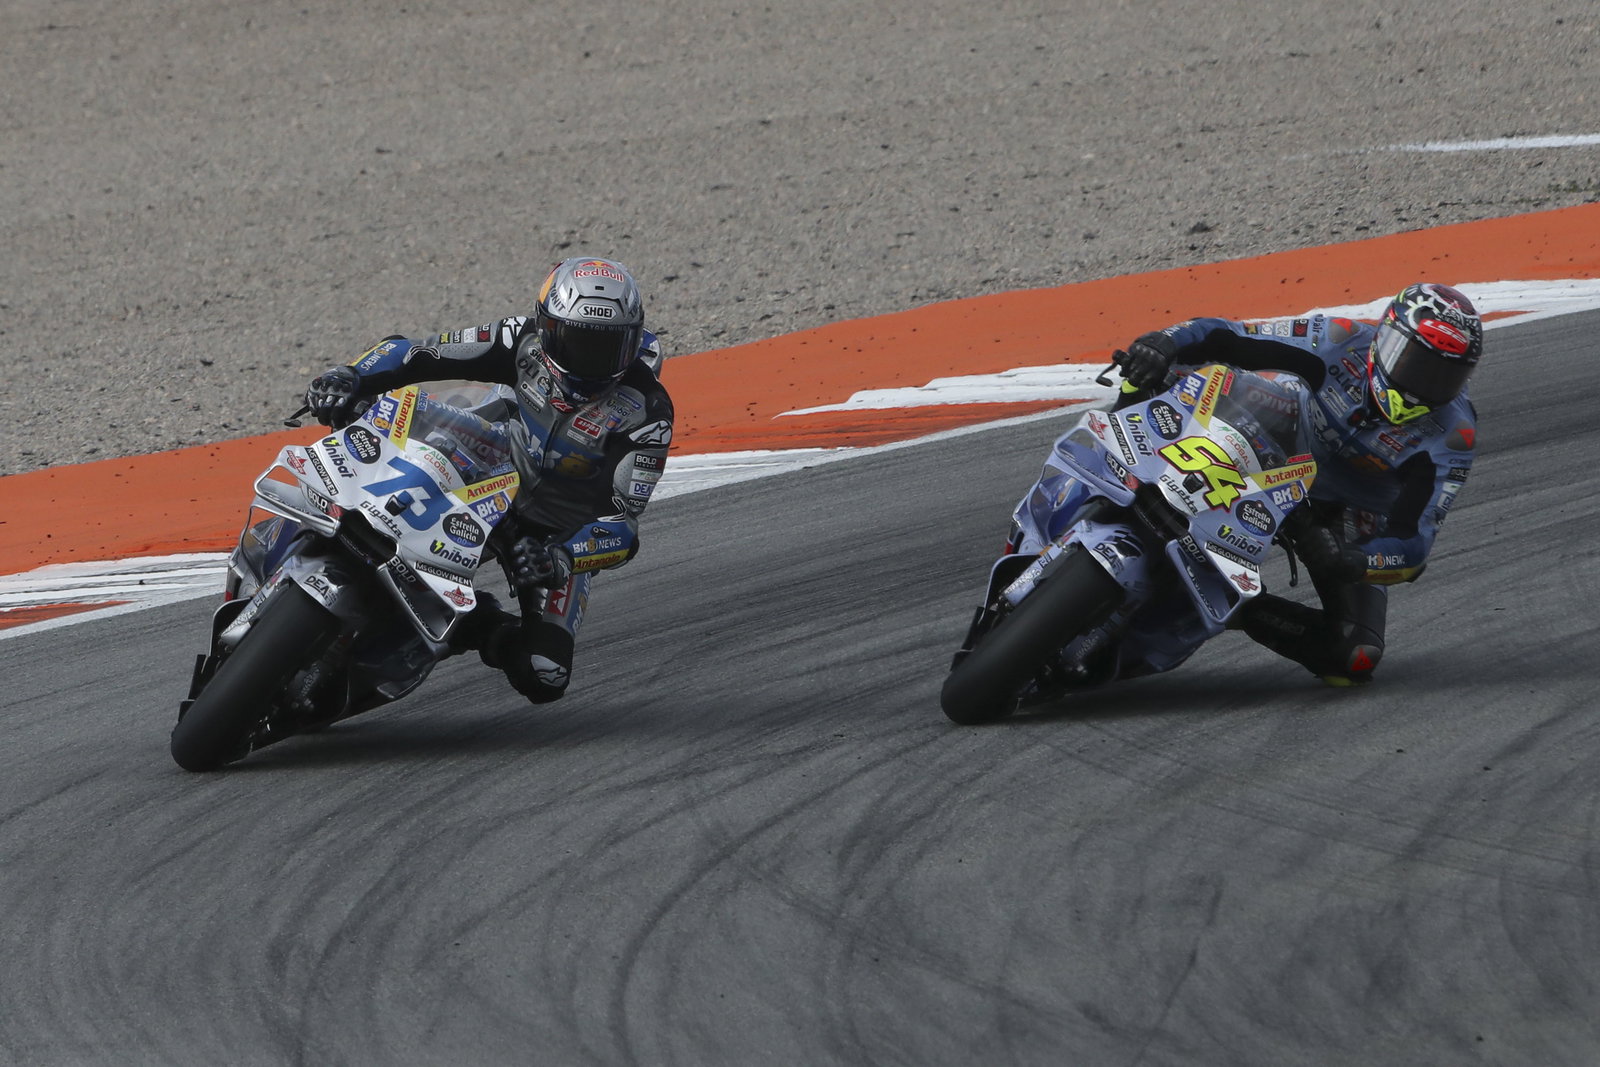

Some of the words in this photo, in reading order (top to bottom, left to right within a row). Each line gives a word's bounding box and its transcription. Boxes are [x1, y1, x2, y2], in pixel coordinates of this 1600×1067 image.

[575, 268, 599, 278] Red
[601, 269, 624, 282] Bull
[565, 320, 587, 329] GIVES
[583, 306, 613, 318] SHOEI
[1180, 375, 1202, 405] BK8
[1199, 368, 1224, 416] Antangin
[373, 400, 395, 430] BK8
[394, 391, 416, 439] Antangin
[1153, 408, 1169, 434] Galicia
[1160, 405, 1178, 433] Estrella
[350, 433, 367, 459] Galicia
[355, 430, 376, 457] Estrella
[1126, 413, 1153, 457] Unibat
[322, 437, 353, 479] Unibat
[429, 450, 448, 466] AUS
[636, 455, 657, 465] BOLD
[1225, 435, 1250, 468] GLOBAL
[423, 454, 453, 485] GLOBAL
[1106, 454, 1126, 477] BOLD
[1157, 435, 1247, 512] 54
[1265, 465, 1313, 485] Antangin
[308, 489, 328, 509] BOLD
[467, 475, 515, 500] Antangin
[1159, 474, 1199, 517] Gigetta
[1272, 483, 1301, 506] BK8
[477, 495, 507, 516] BK8
[1244, 504, 1271, 524] Estrella
[360, 501, 402, 538] Gigetta
[451, 517, 480, 535] Estrella
[1242, 512, 1268, 530] Galicia
[450, 526, 477, 542] Galicia
[572, 538, 597, 553] BK8
[599, 537, 621, 549] NEWS
[1217, 524, 1262, 556] Unibat
[430, 539, 479, 569] Unibat
[1182, 534, 1206, 563] BOLD
[390, 555, 416, 583] BOLD
